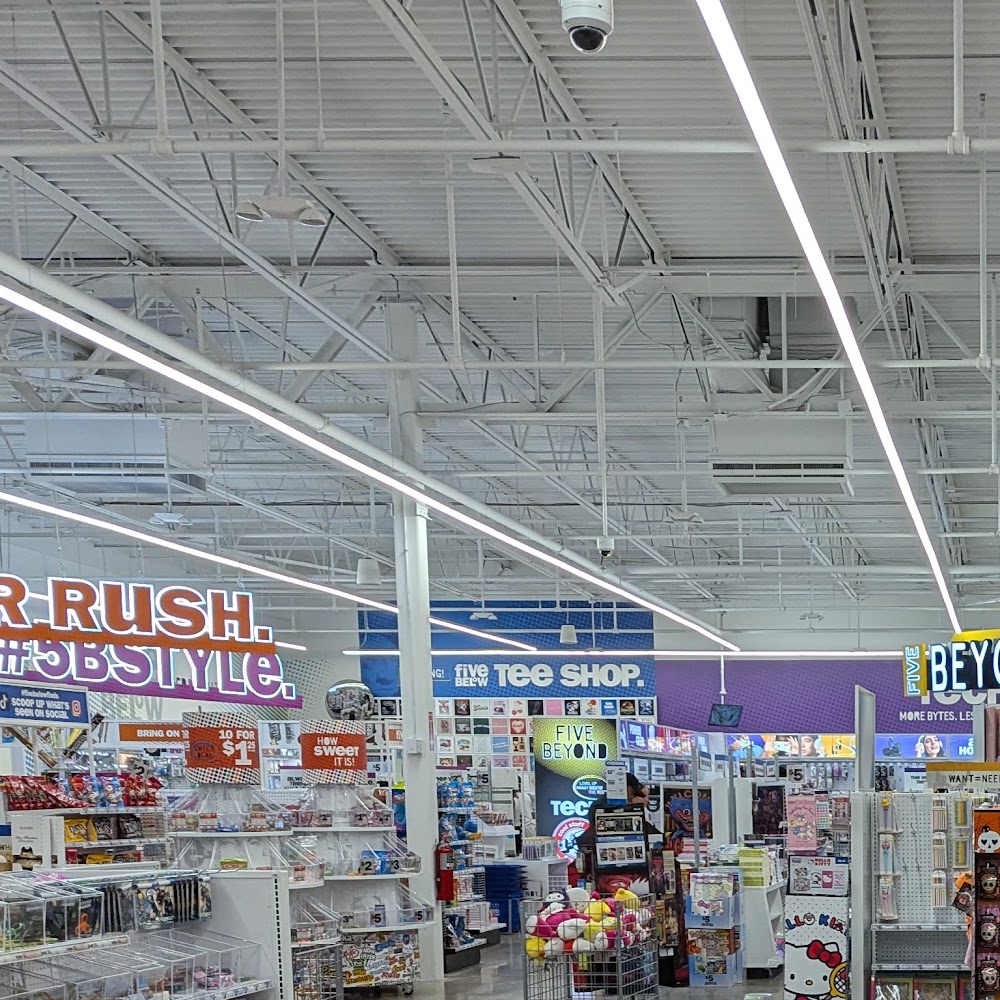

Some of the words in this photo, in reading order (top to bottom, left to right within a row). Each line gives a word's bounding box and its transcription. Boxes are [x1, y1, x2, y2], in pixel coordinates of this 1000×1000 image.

[559, 663, 645, 687] SHOP.
[904, 645, 921, 697] FIVE
[11, 697, 35, 708] SCOOP
[36, 698, 45, 709] UP
[35, 708, 44, 718] ON
[899, 711, 926, 721] MORE
[927, 711, 958, 721] BYTES.
[166, 729, 180, 738] ON
[219, 730, 233, 740] 10
[236, 730, 255, 740] FOR
[555, 724, 593, 742] FIVE
[317, 736, 338, 746] HOW
[542, 742, 608, 760] BEYOND
[334, 757, 342, 766] IT
[344, 757, 355, 766] IS!
[789, 769, 803, 781] $5
[360, 860, 373, 871] $2
